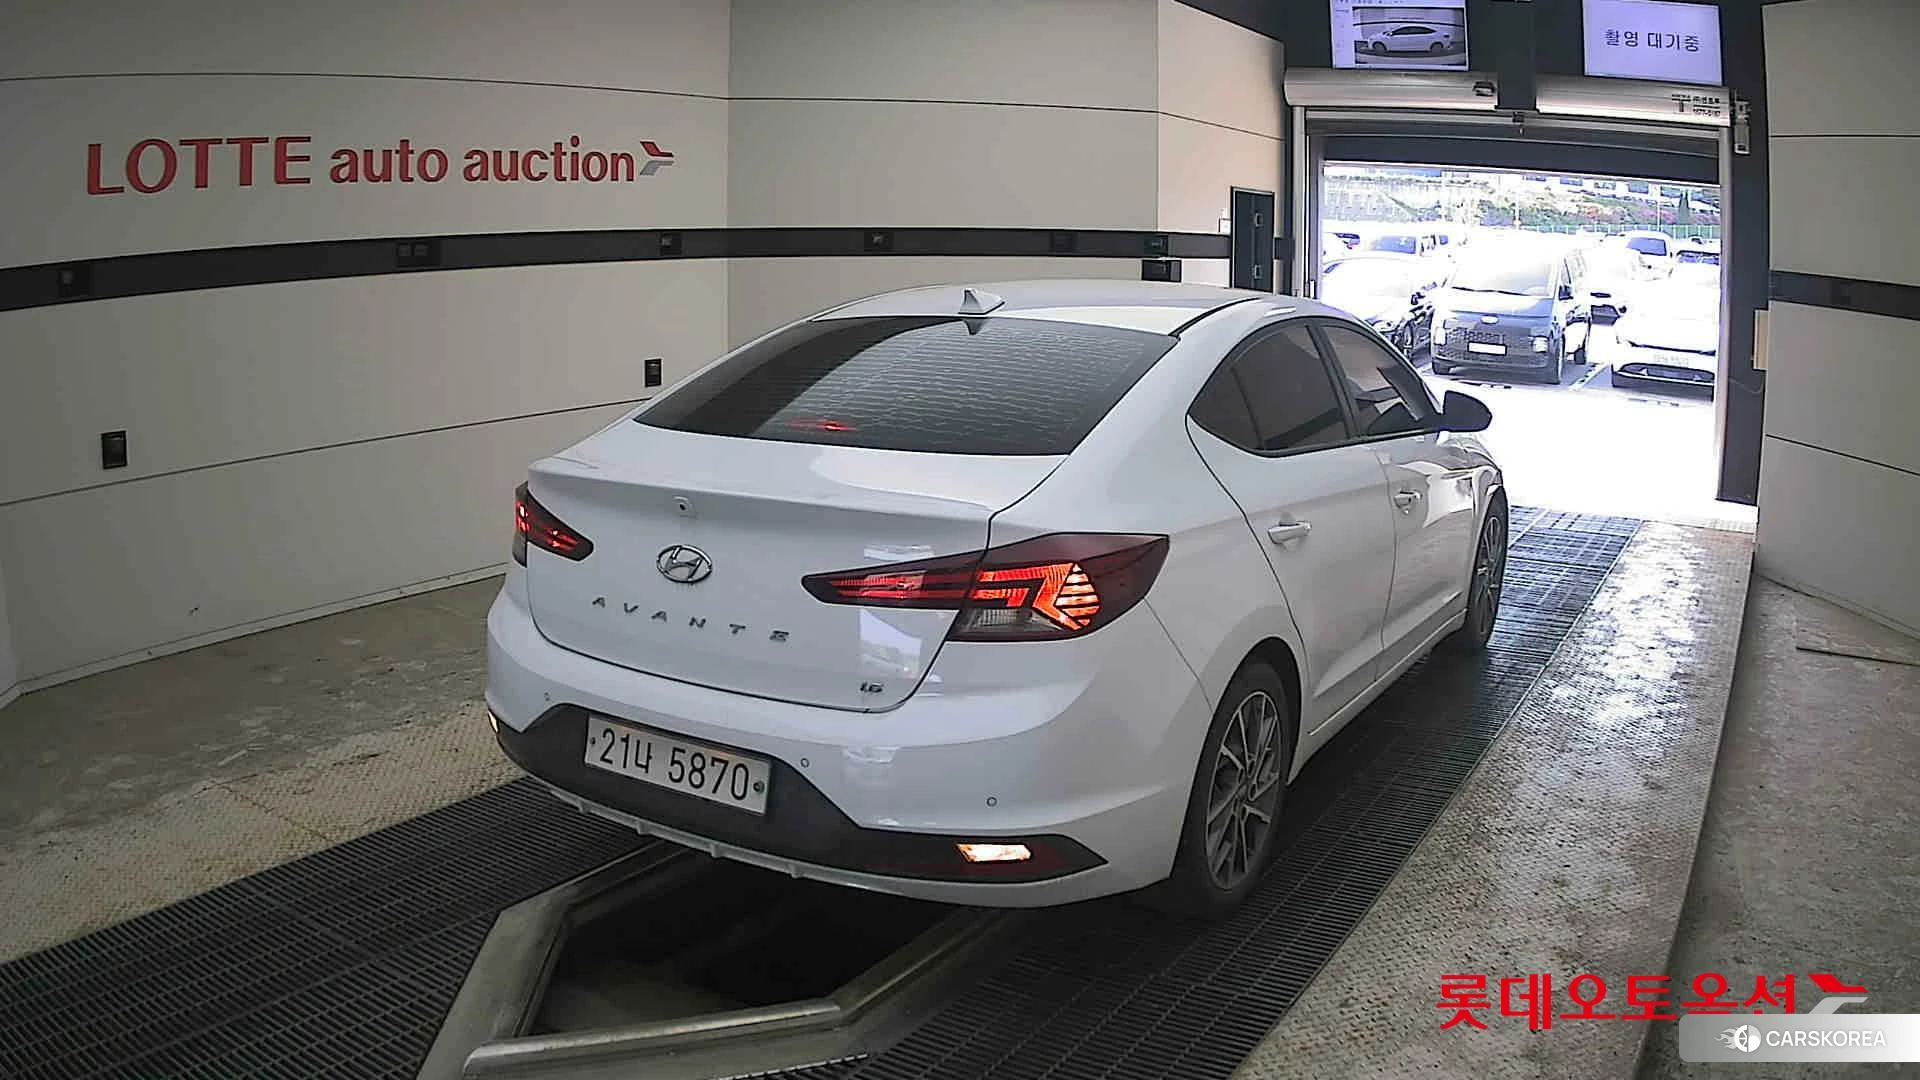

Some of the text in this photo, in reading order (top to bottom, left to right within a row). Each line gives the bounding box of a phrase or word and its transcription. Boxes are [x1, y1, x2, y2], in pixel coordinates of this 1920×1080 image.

[1604, 29, 1700, 53] 촬영 대기중
[86, 135, 636, 195] LOTTE auto auction
[591, 596, 790, 643] AVANTE
[668, 747, 750, 801] 5870
